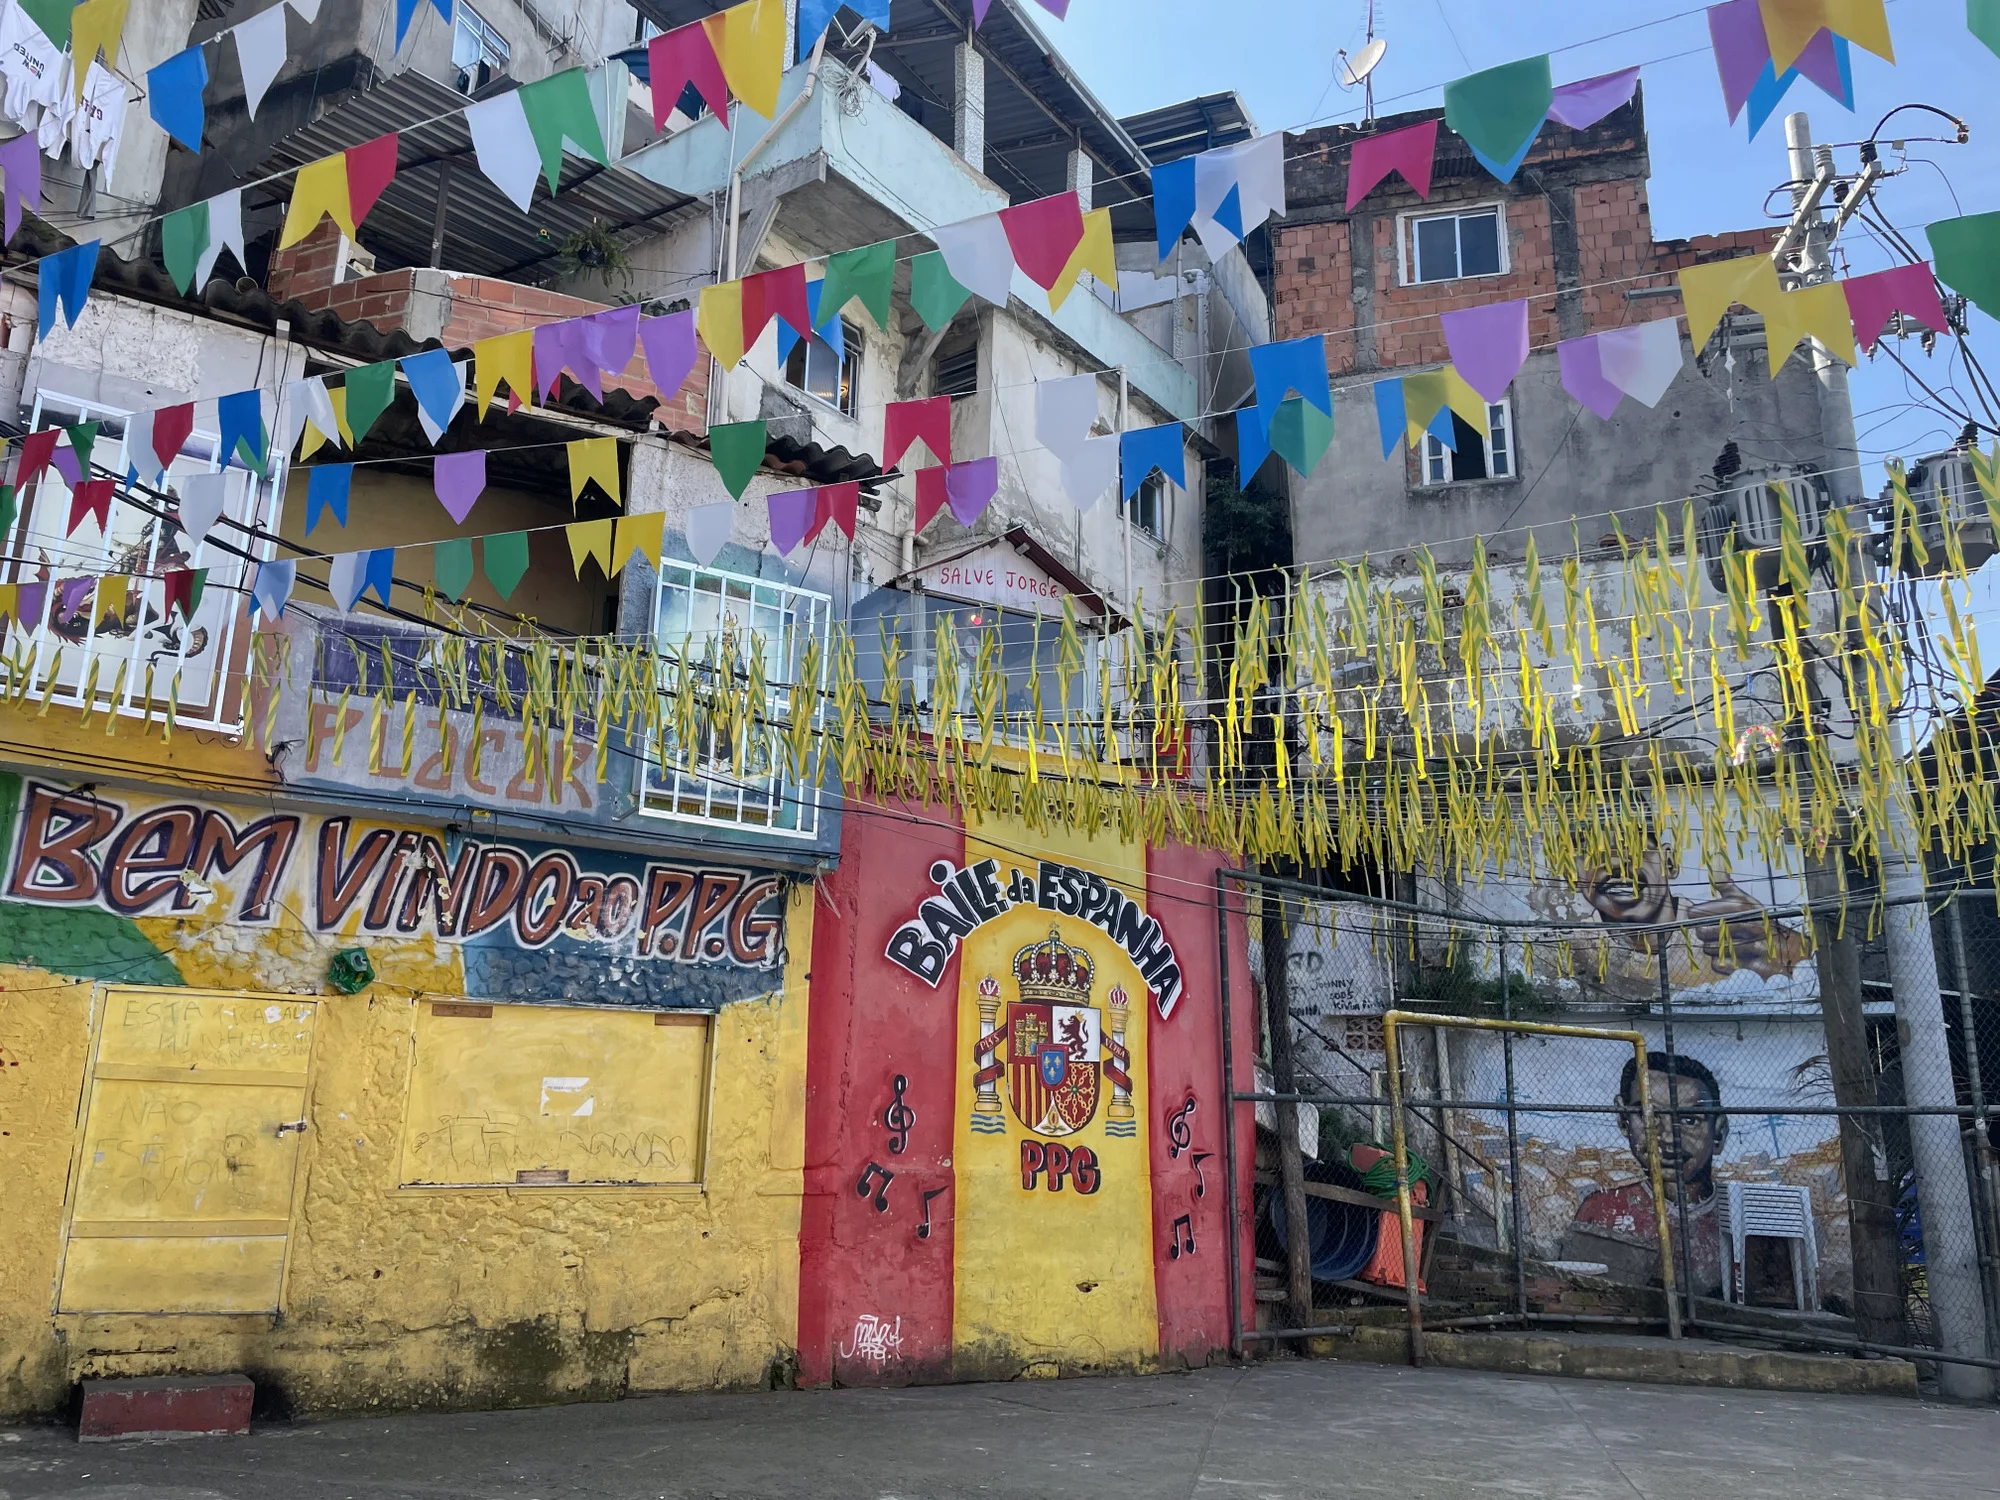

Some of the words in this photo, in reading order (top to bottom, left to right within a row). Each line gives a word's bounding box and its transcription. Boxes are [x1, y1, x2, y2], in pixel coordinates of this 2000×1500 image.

[13, 42, 45, 72] UNITED
[940, 567, 994, 586] SALVE
[1006, 571, 1058, 599] JORGE
[1006, 868, 1036, 905] da
[1037, 860, 1183, 1020] ESPANHA
[1021, 1140, 1101, 1194] PPG
